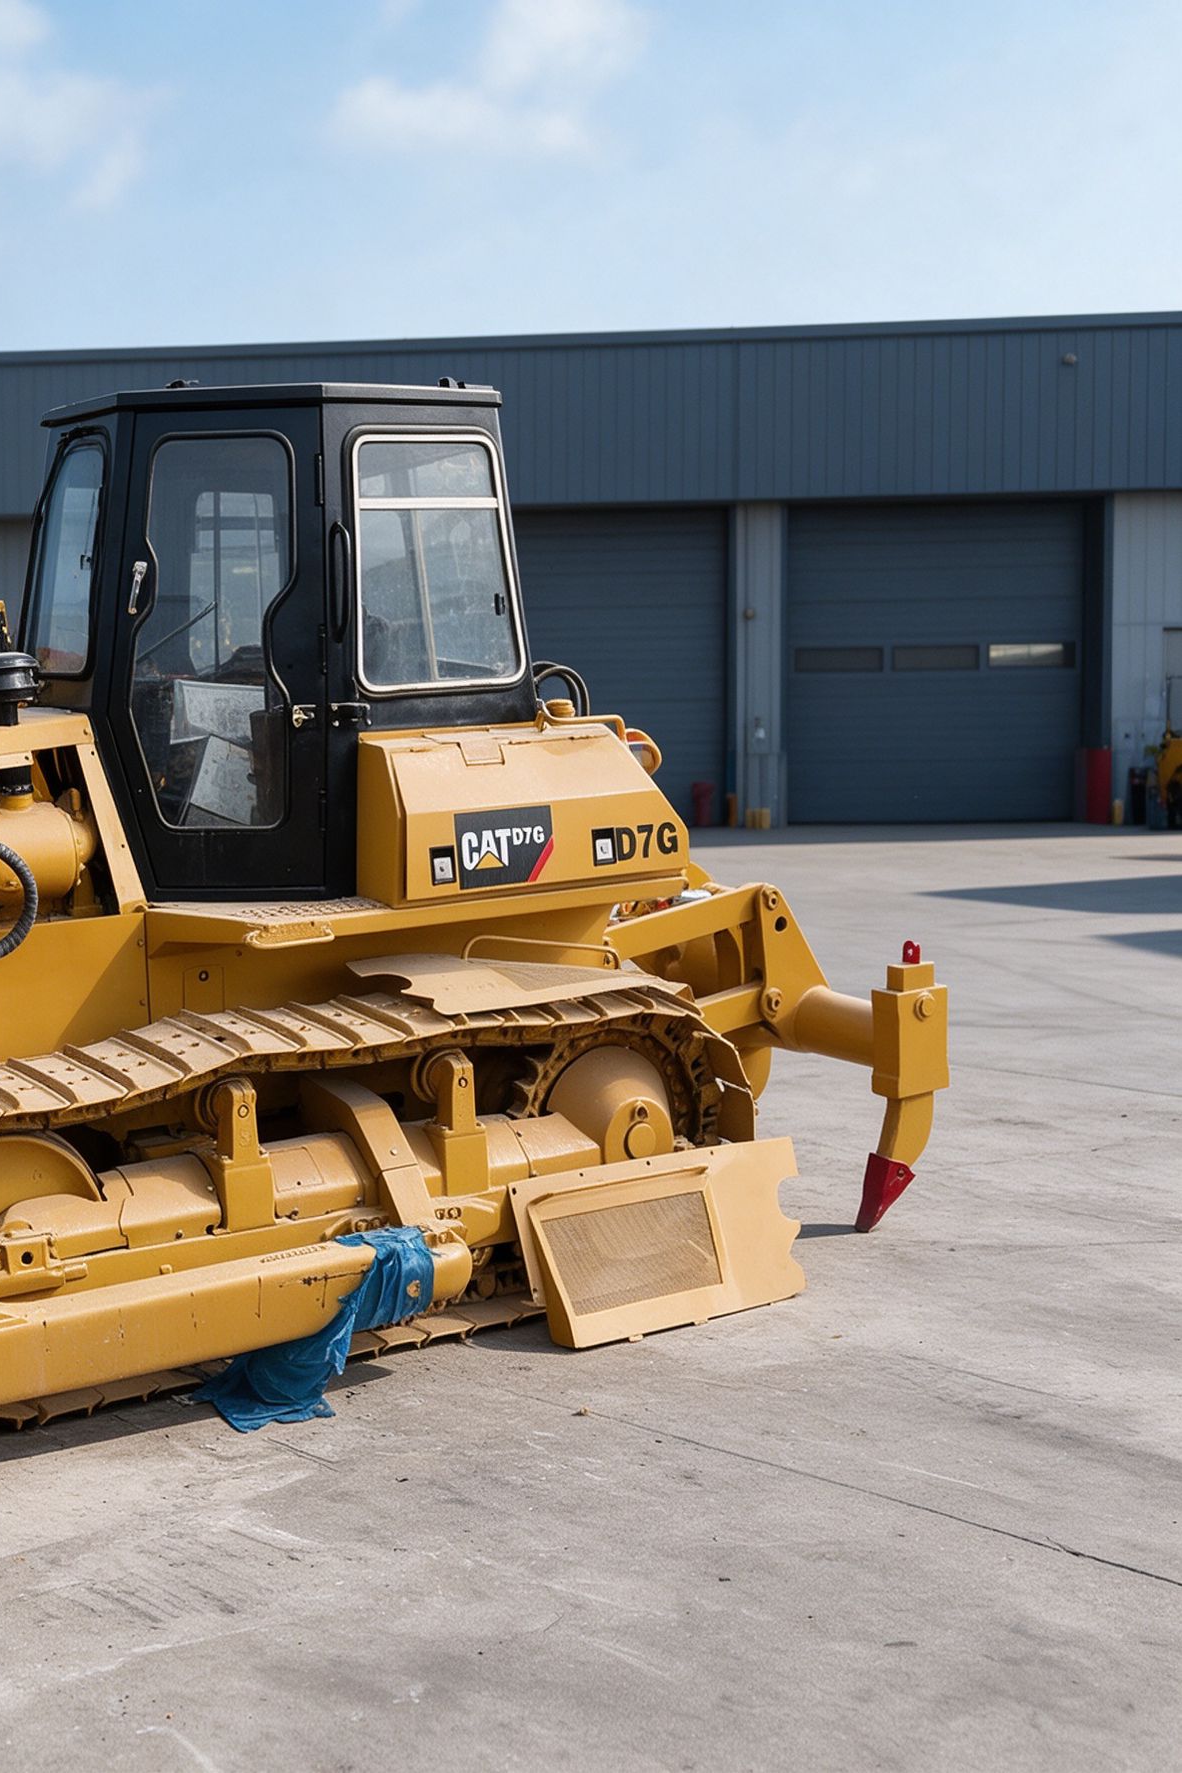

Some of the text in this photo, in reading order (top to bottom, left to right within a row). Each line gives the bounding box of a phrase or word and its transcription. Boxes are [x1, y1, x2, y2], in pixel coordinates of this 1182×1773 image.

[461, 825, 545, 871] CAT D7G
[616, 822, 679, 862] D7G
